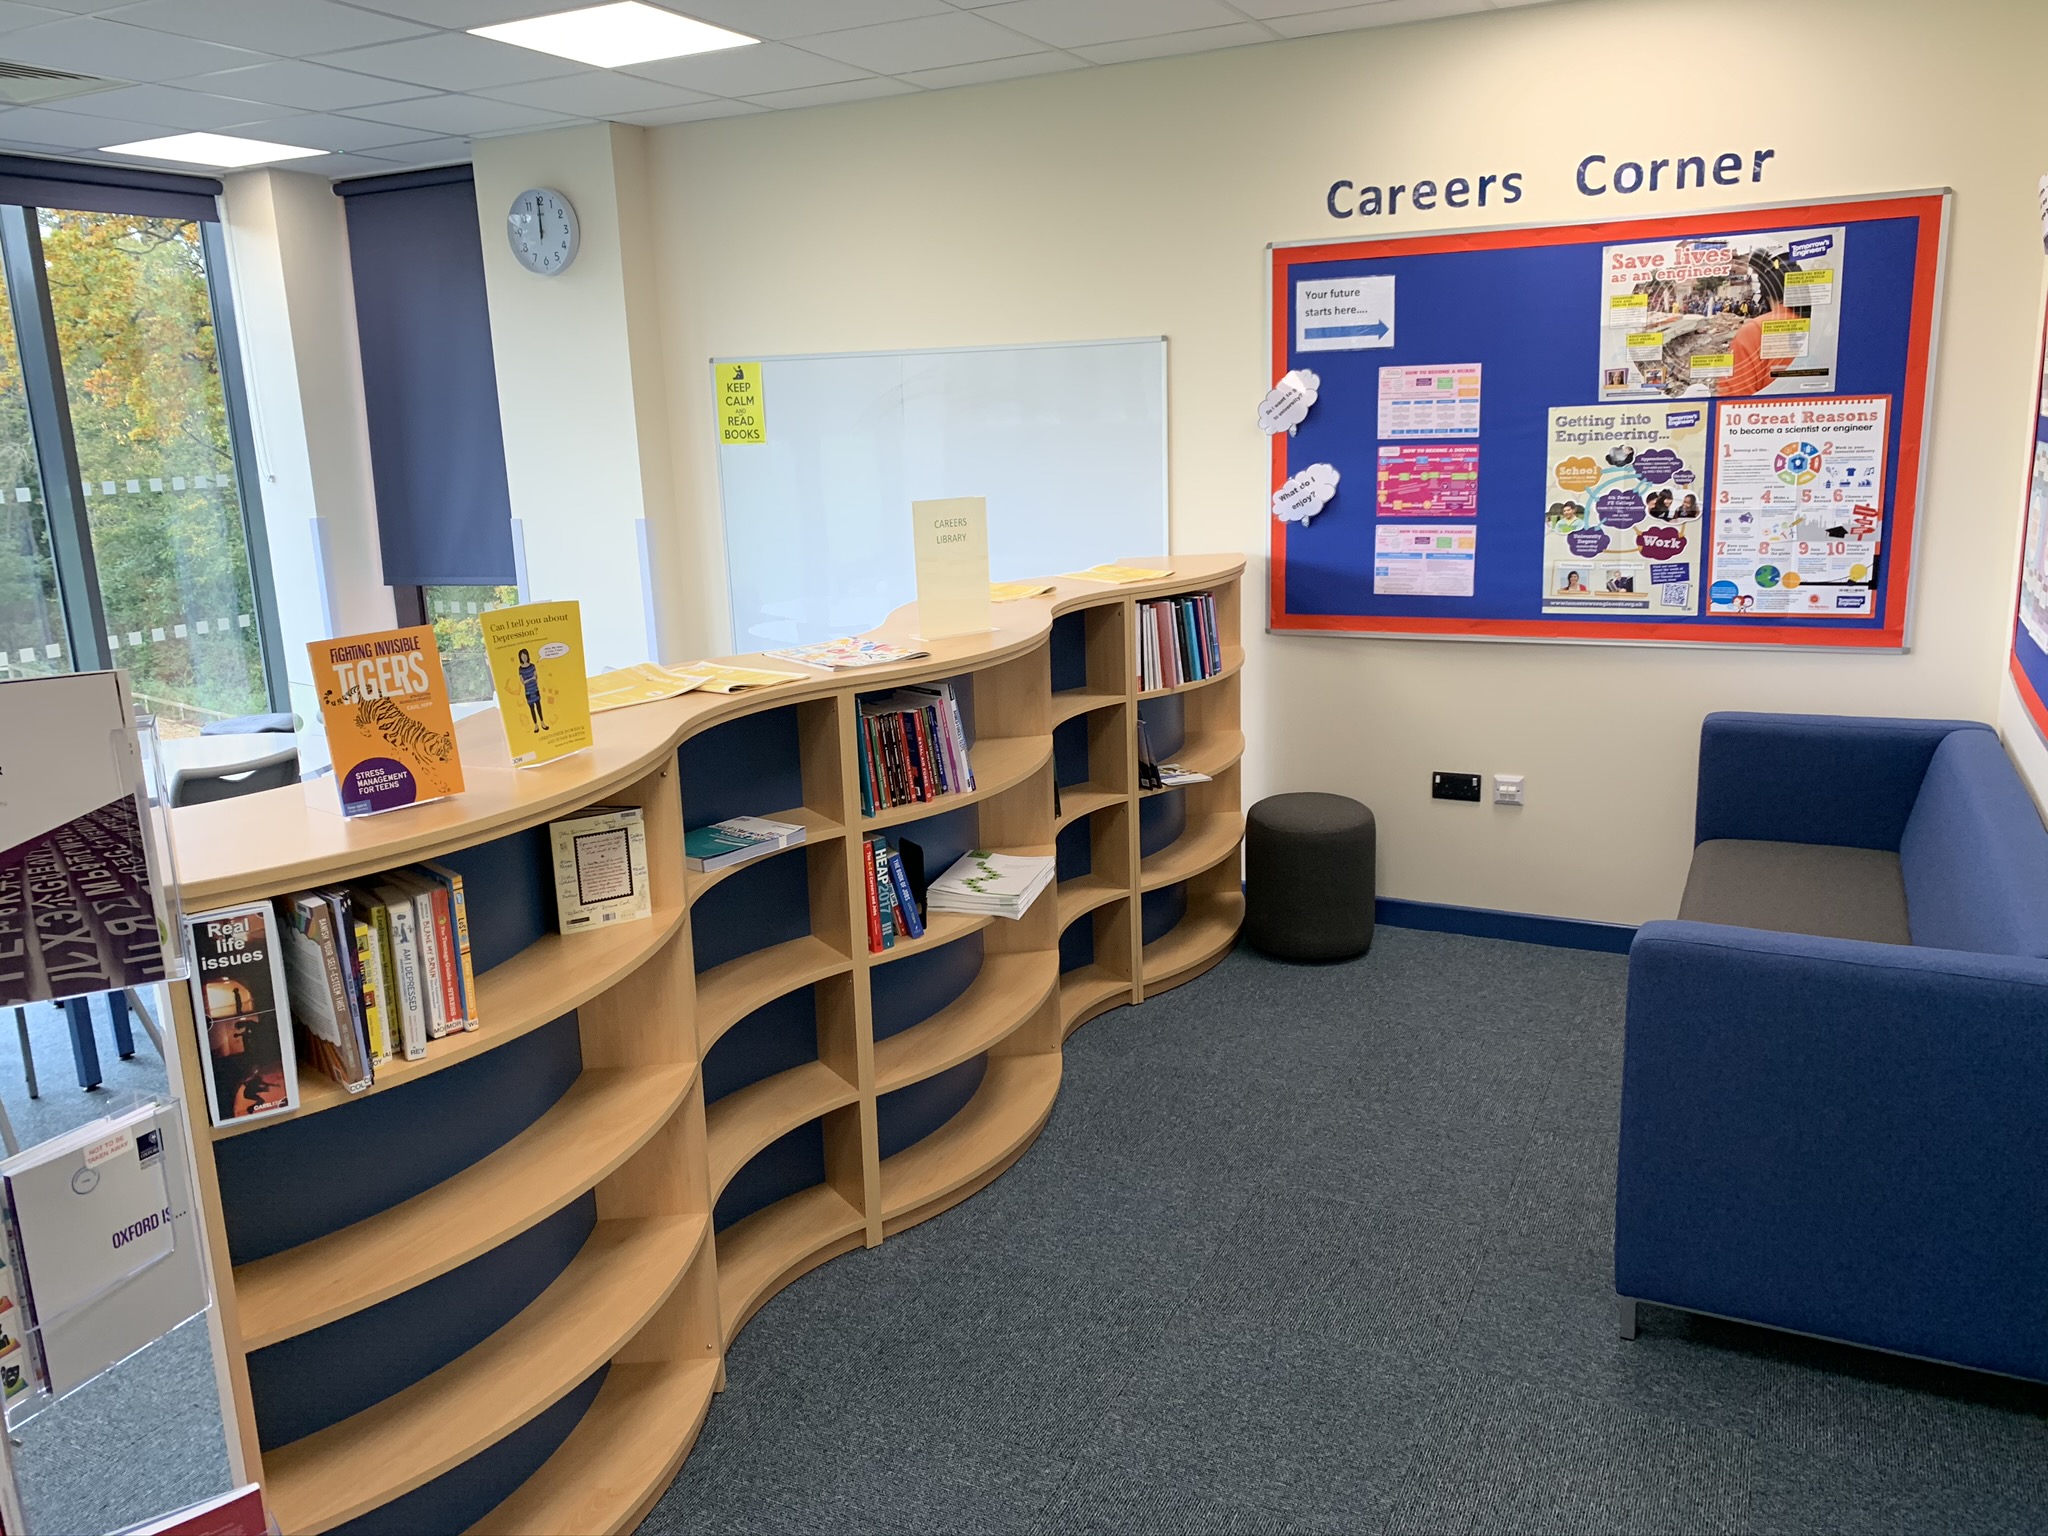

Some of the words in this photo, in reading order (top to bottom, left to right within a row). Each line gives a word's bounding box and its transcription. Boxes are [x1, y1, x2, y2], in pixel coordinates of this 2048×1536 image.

[1327, 170, 1522, 219] Careers
[1576, 149, 1775, 196] Corner
[525, 201, 532, 212] 11
[549, 199, 553, 209] 1
[557, 209, 563, 219] 2
[517, 228, 523, 237] 9
[563, 224, 569, 235] 3
[522, 243, 528, 253] 8
[561, 240, 567, 250] 4
[1791, 239, 1830, 252] Tomorrow's
[1792, 246, 1826, 257] Engineers
[532, 253, 538, 263] 7
[543, 256, 550, 266] 6
[554, 251, 560, 261] 5
[1612, 253, 1665, 270] Save
[1673, 248, 1732, 266] lives
[1611, 273, 1626, 283] as
[1632, 272, 1651, 281] an
[1657, 265, 1731, 282] engineer
[1305, 290, 1328, 300] Your
[1330, 289, 1360, 298] future
[1305, 307, 1332, 317] starts
[727, 383, 751, 393] KEEP
[726, 396, 754, 406] CALM
[1274, 396, 1287, 408] want
[1278, 393, 1303, 417] university?
[728, 416, 754, 426] READ
[1555, 414, 1615, 429] Getting
[1620, 414, 1652, 426] into
[1725, 414, 1741, 426] 10
[1747, 412, 1796, 425] Great
[1802, 410, 1878, 424] Reasons
[724, 429, 760, 440] BOOKS
[1555, 428, 1670, 445] Engineering...
[1740, 427, 1775, 435] become
[1785, 426, 1820, 434] scientist
[1833, 424, 1873, 433] engineer
[1723, 444, 1732, 458] 1
[1821, 441, 1834, 456] 2
[1558, 466, 1598, 475] School
[1278, 487, 1299, 502] What
[1291, 491, 1317, 510] enjoy?
[1720, 490, 1729, 504] 3
[1760, 490, 1771, 504] 4
[1801, 489, 1812, 502] 5
[1833, 488, 1843, 502] 6
[934, 518, 968, 529] CAREERS
[936, 533, 967, 544] LIBRARY
[1642, 535, 1681, 550] Work
[1716, 542, 1726, 556] 7
[1759, 542, 1770, 554] 8
[1798, 542, 1809, 555] 9
[1827, 541, 1846, 556] 10
[490, 623, 506, 633] Can
[506, 621, 510, 629] I
[511, 619, 524, 628] tell
[525, 617, 541, 628] you
[543, 614, 568, 623] about
[492, 627, 539, 644] Depression?
[355, 768, 385, 780] STRESS
[357, 771, 408, 788] MANAGEMENT
[358, 786, 374, 795] FOR
[374, 780, 400, 792] TEENS
[875, 848, 889, 885] HEAP
[895, 869, 904, 882] BOOK
[900, 881, 907, 890] OF
[878, 884, 891, 914] 2017
[902, 887, 910, 901] JOBS
[207, 918, 250, 938] Real
[319, 918, 327, 941] BANISH
[422, 920, 432, 943] BLAME
[216, 938, 245, 954] life
[323, 941, 334, 960] YOUR
[427, 944, 434, 956] MY
[201, 950, 264, 971] issues
[403, 948, 411, 960] AM
[427, 957, 437, 978] BRAIN
[327, 956, 342, 996] SELF-ESTEEM
[441, 936, 449, 960] Teenage
[448, 986, 457, 1016] STRESS
[404, 965, 418, 1011] DEPRESSED
[336, 995, 346, 1012] THIEF
[446, 1021, 462, 1030] MOR
[410, 1047, 425, 1056] REY
[350, 1083, 365, 1092] COL
[87, 1151, 110, 1164] TAKEN
[110, 1141, 129, 1153] AWAY
[88, 1146, 103, 1156] NOT
[104, 1140, 114, 1148] TO
[115, 1135, 124, 1144] BE
[111, 1213, 160, 1249] OXFORD
